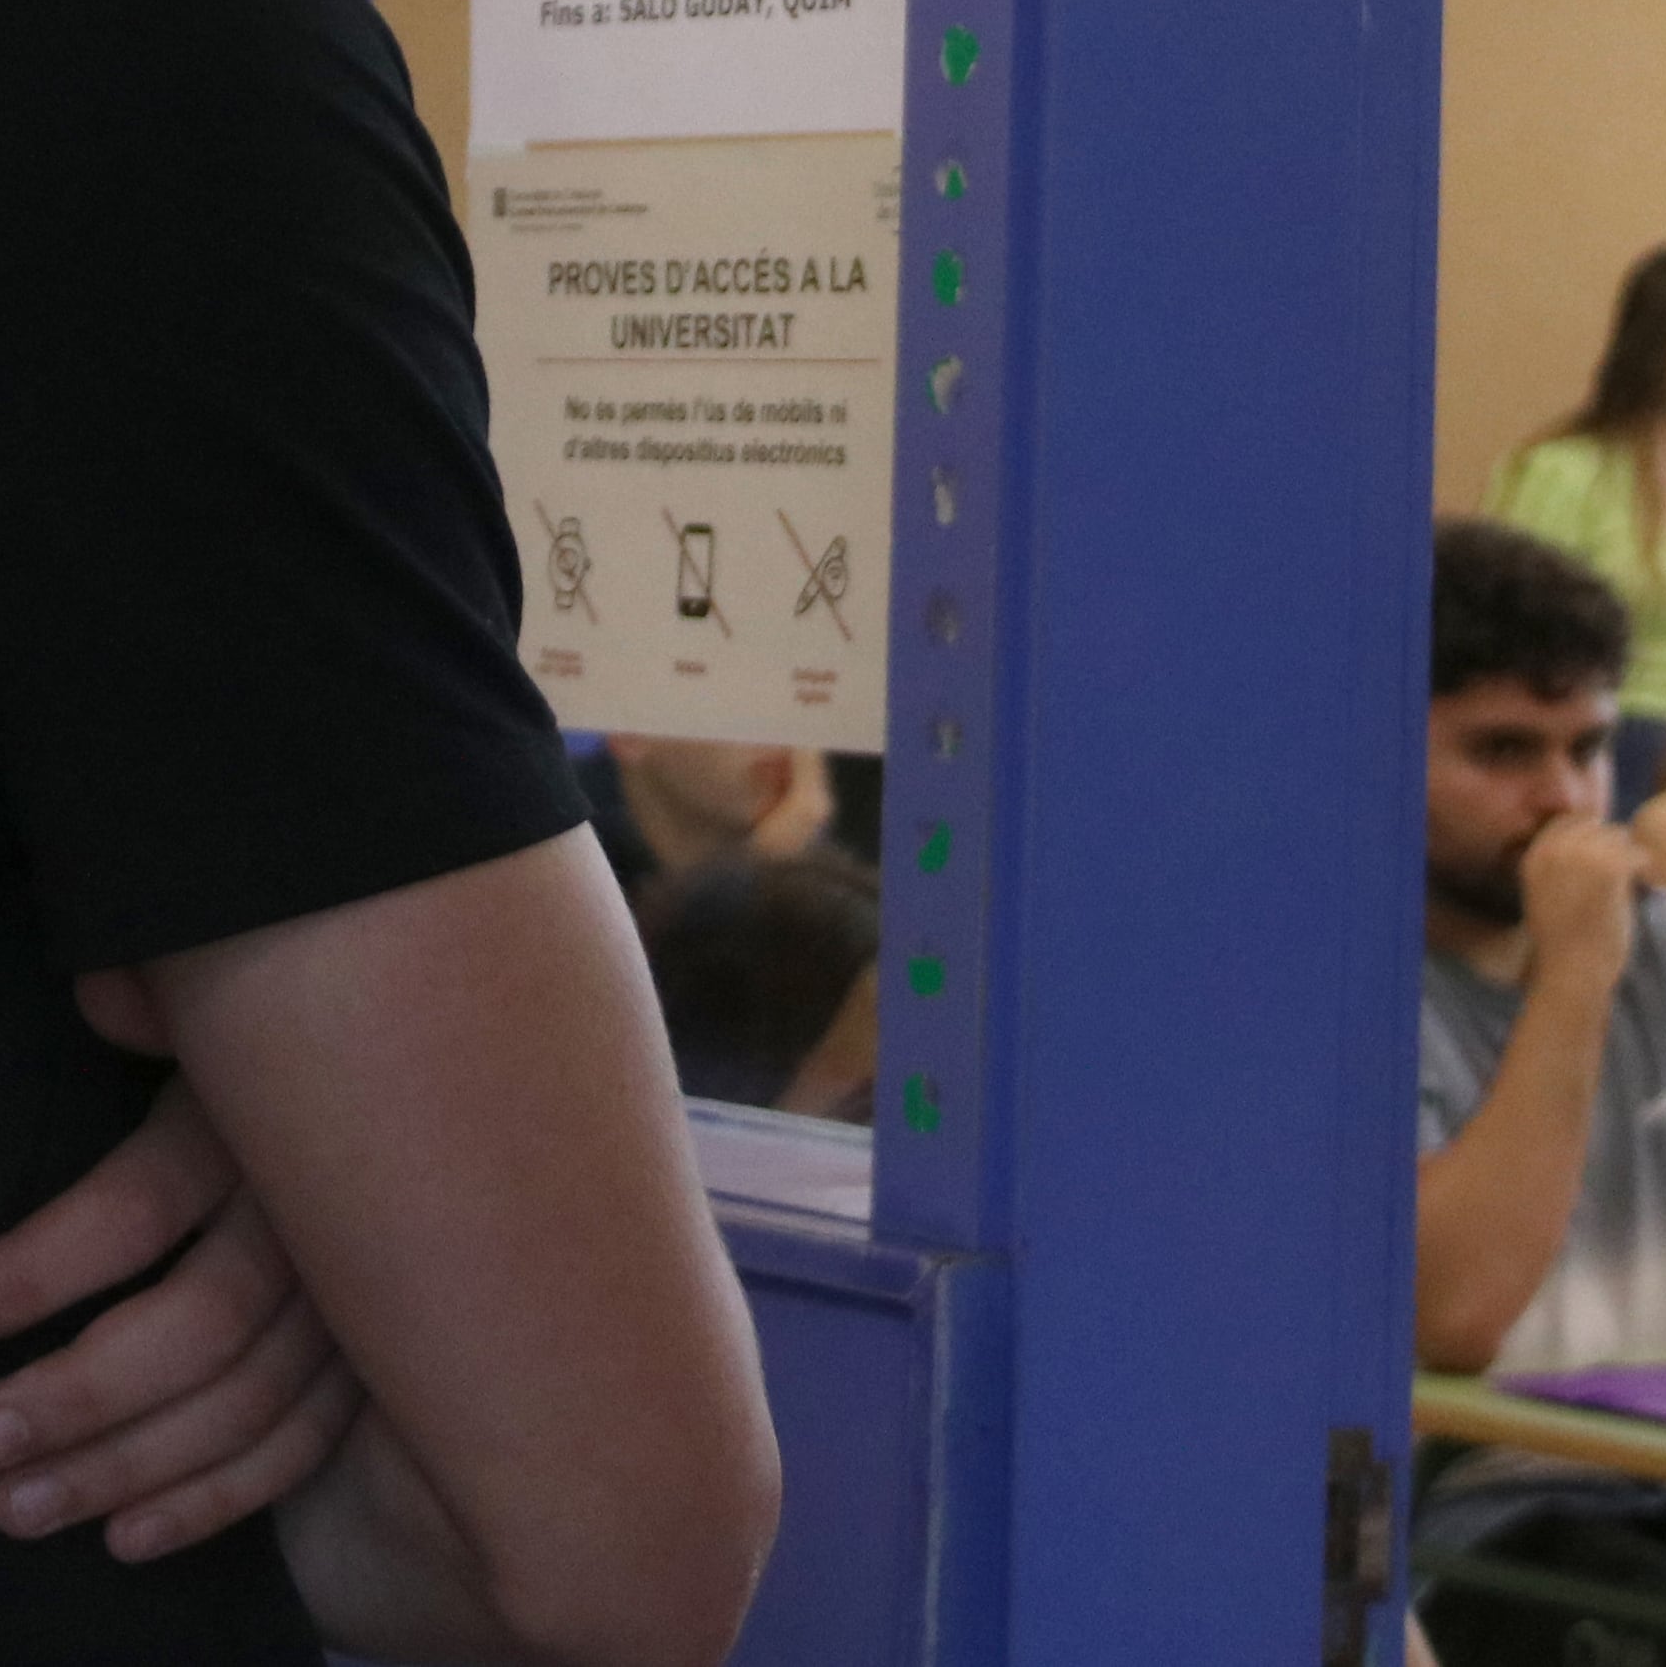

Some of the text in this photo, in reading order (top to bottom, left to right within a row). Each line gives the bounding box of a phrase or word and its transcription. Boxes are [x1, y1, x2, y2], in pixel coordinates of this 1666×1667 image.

[591, 4, 611, 24] a:
[548, 248, 867, 297] PROVES D'ACCÉS A LA
[610, 312, 796, 351] UNIVERSITAT
[564, 394, 590, 421] No
[733, 396, 755, 423] de
[636, 436, 735, 468] dispositius
